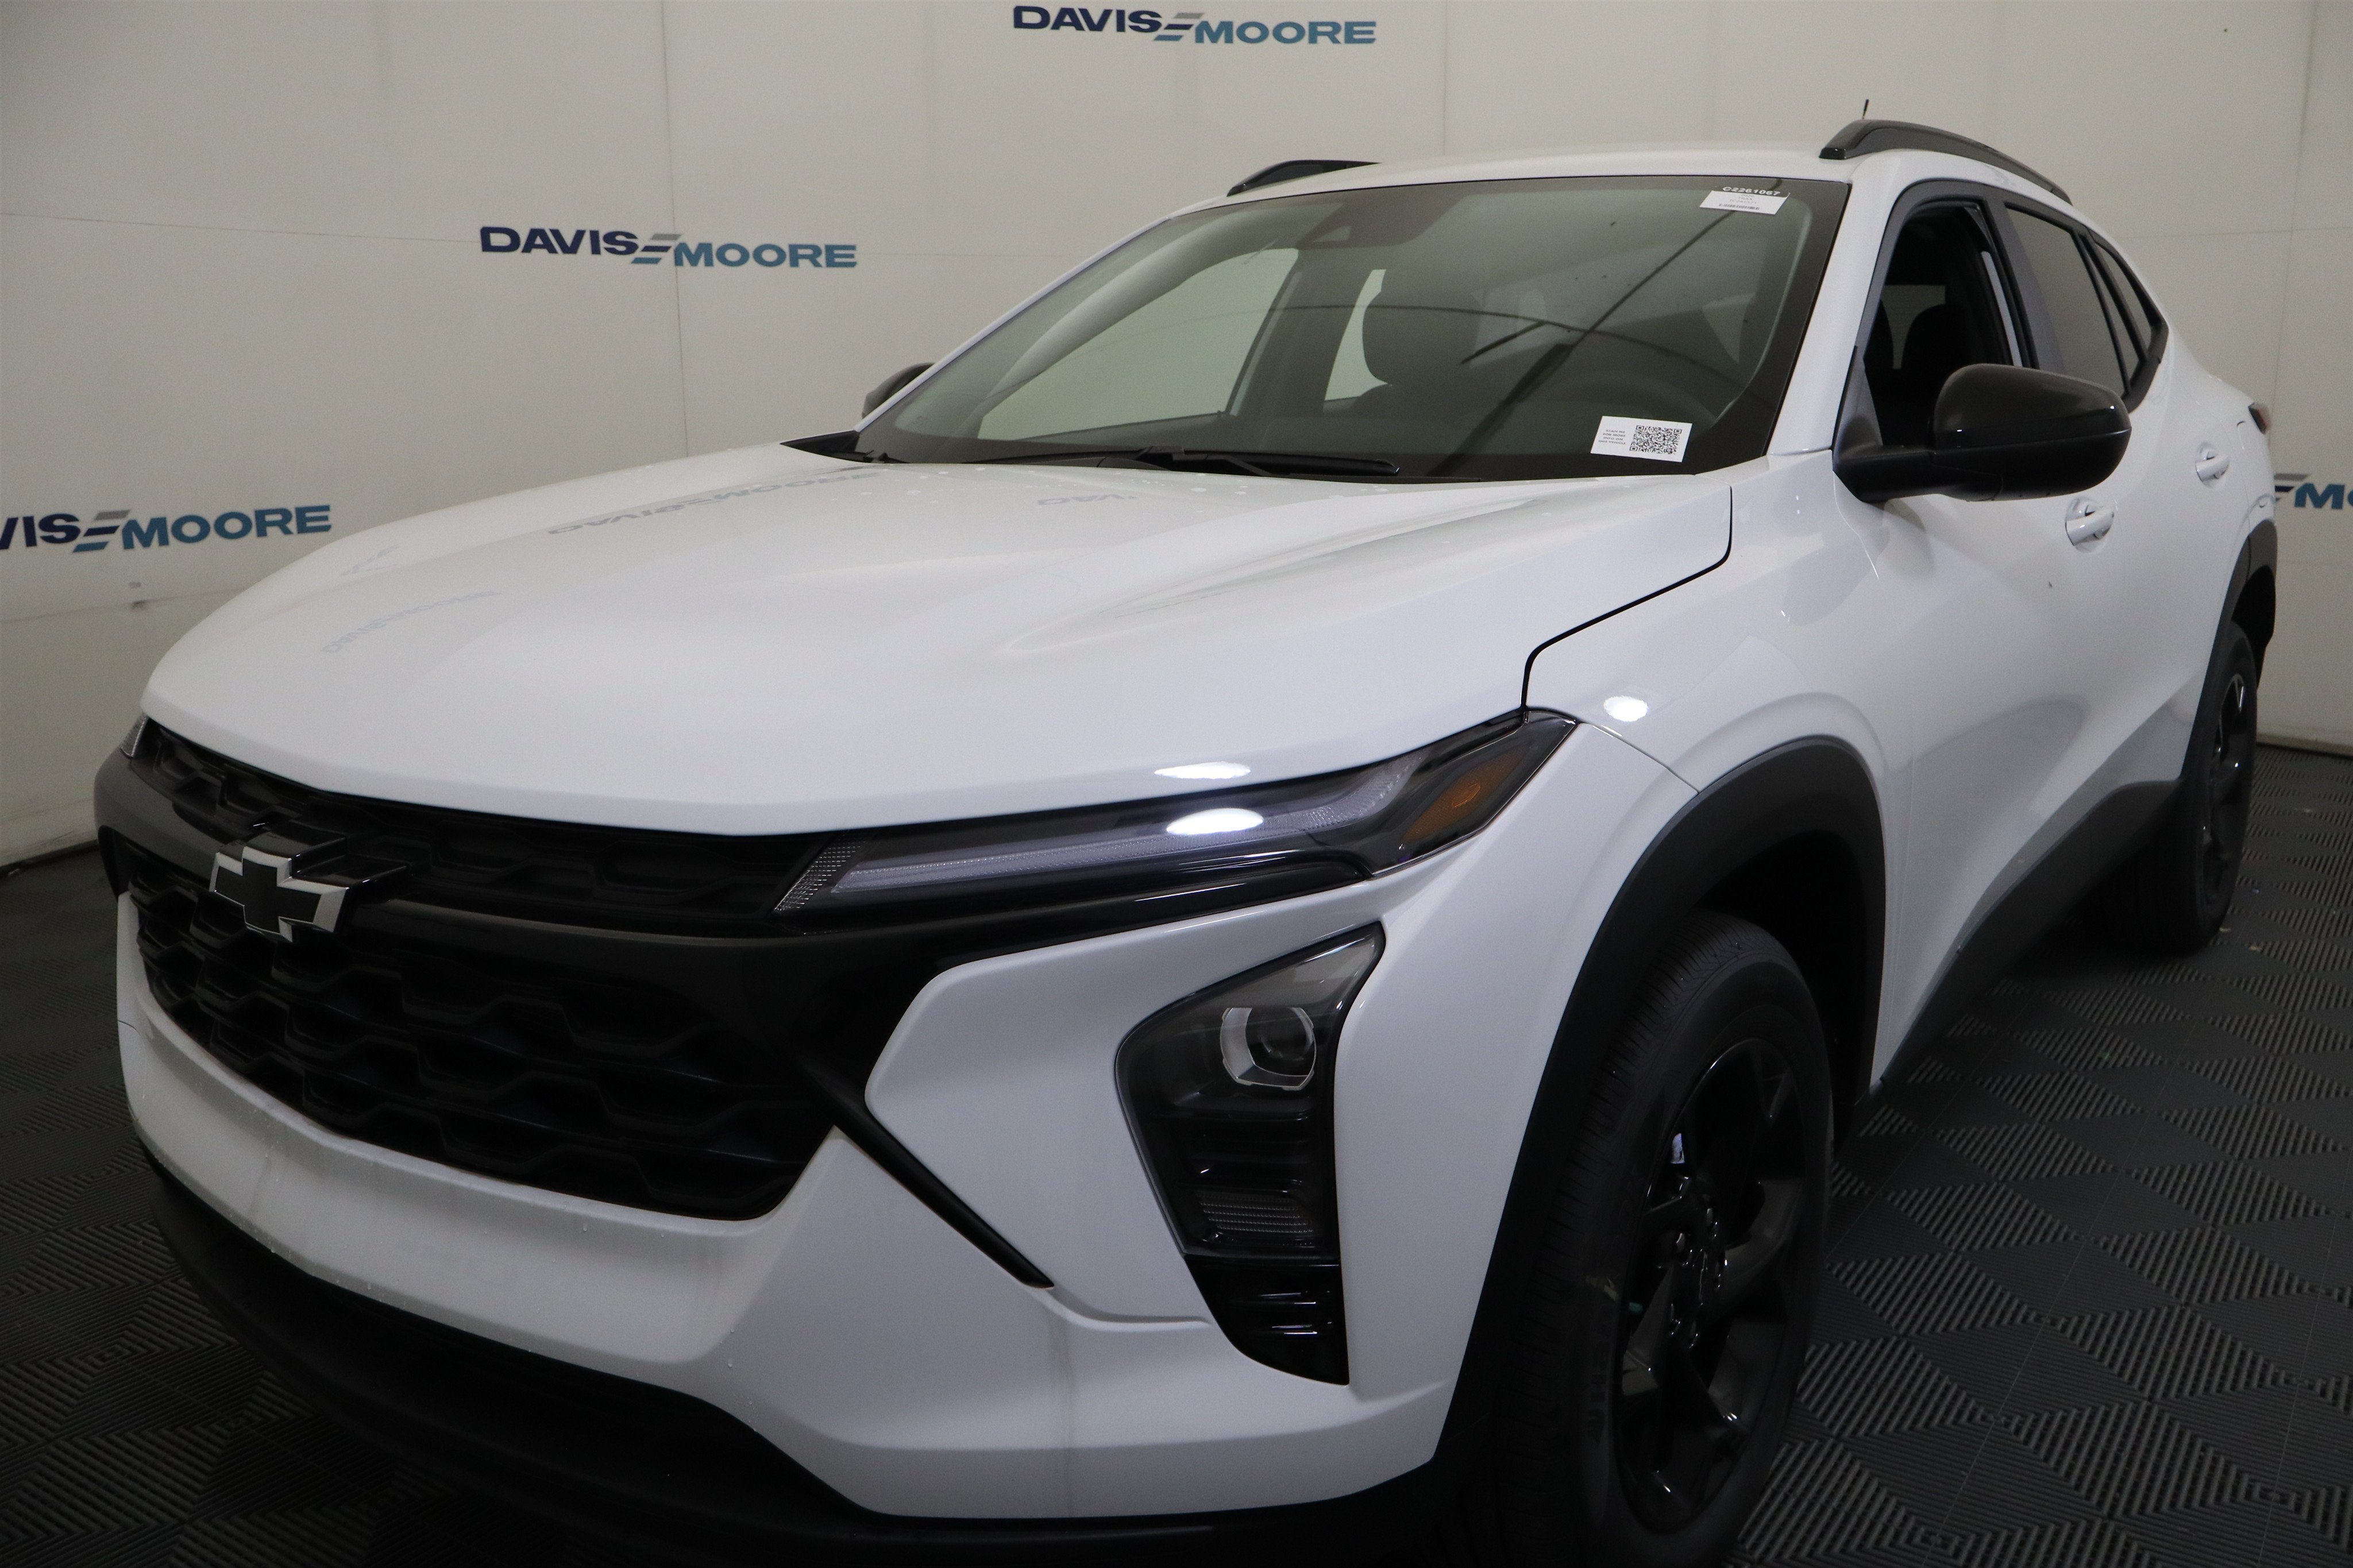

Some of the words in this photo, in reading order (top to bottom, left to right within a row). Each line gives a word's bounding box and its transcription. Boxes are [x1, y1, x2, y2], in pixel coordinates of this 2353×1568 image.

[1013, 6, 1163, 33] DAVIS
[1194, 21, 1377, 44] MOORE
[480, 226, 638, 255] DAVIS
[674, 242, 857, 268] MOORE
[2293, 482, 2353, 509] M
[122, 505, 331, 550] MOORE
